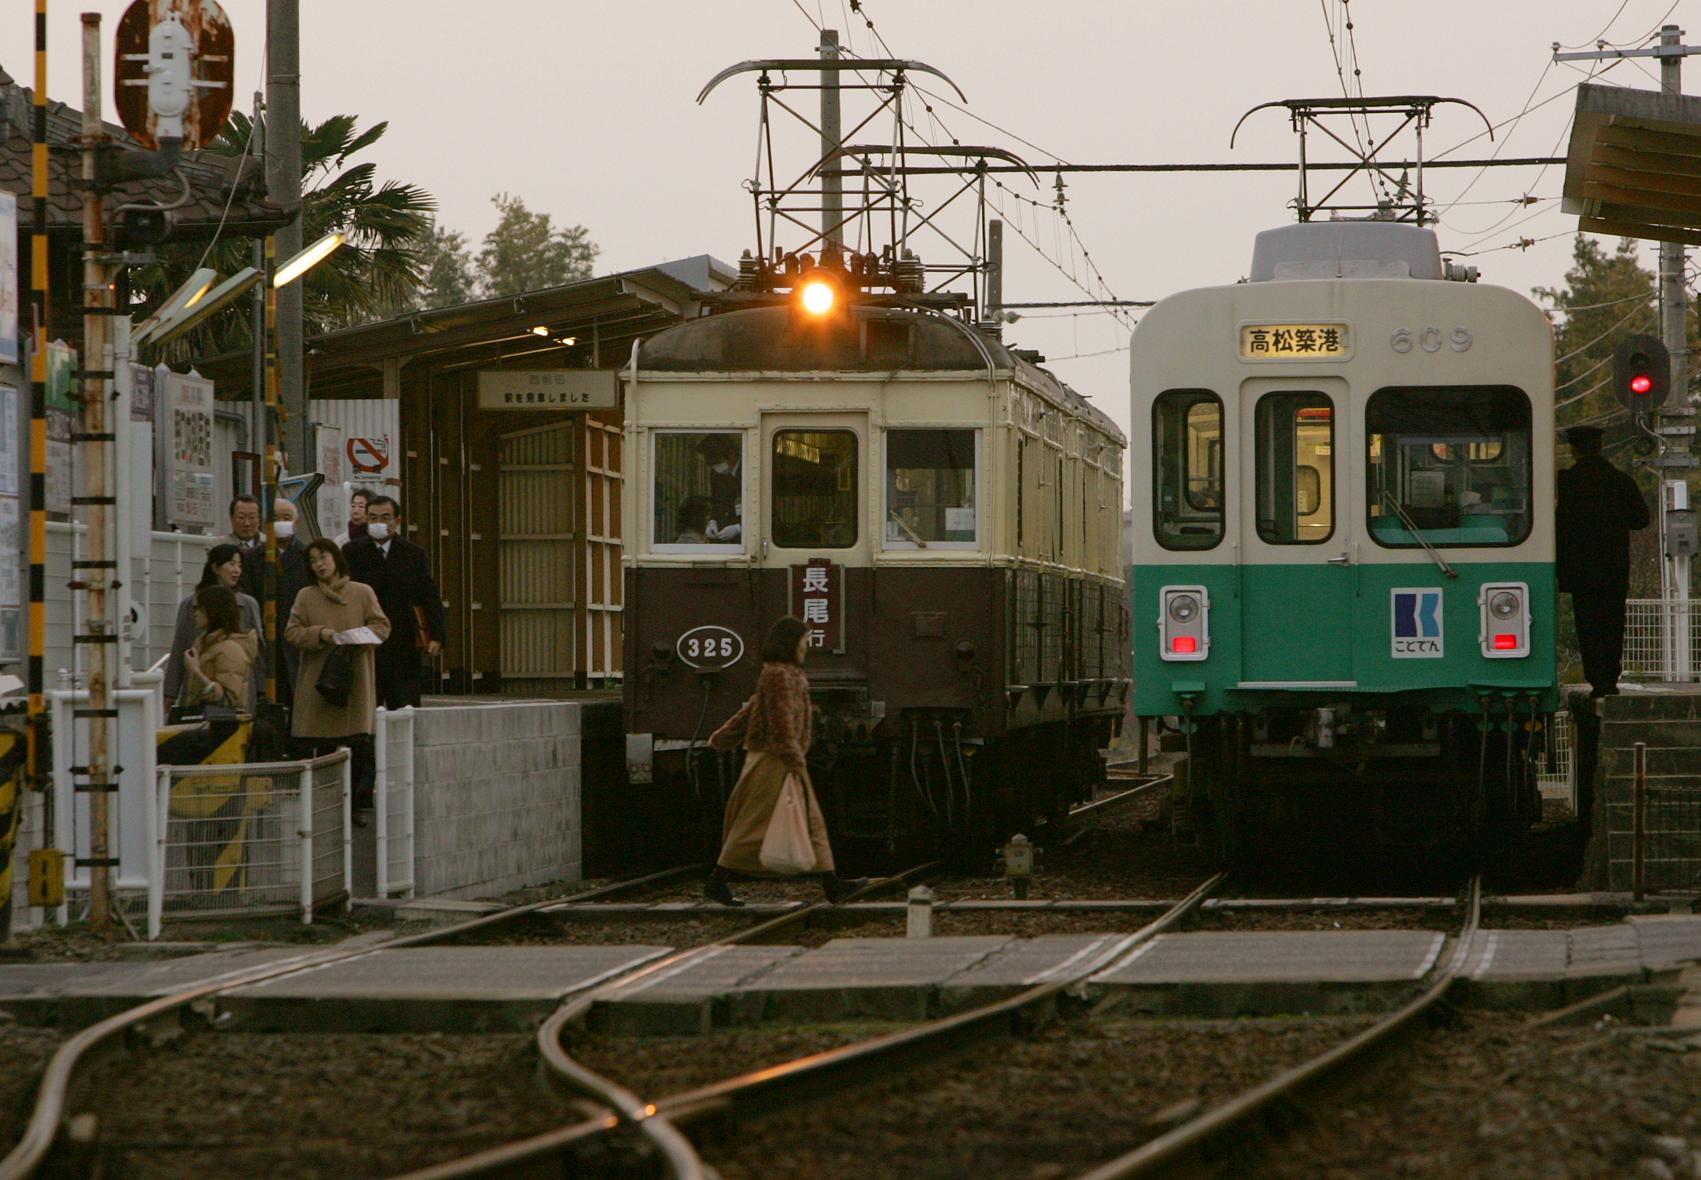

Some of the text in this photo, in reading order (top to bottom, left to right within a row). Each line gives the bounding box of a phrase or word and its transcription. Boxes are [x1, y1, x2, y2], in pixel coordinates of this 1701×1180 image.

[1249, 328, 1340, 353] 高松築港
[1390, 326, 1474, 354] 609
[802, 567, 829, 648] 長尾行
[687, 637, 733, 658] 325
[1395, 640, 1441, 653] ことでん
